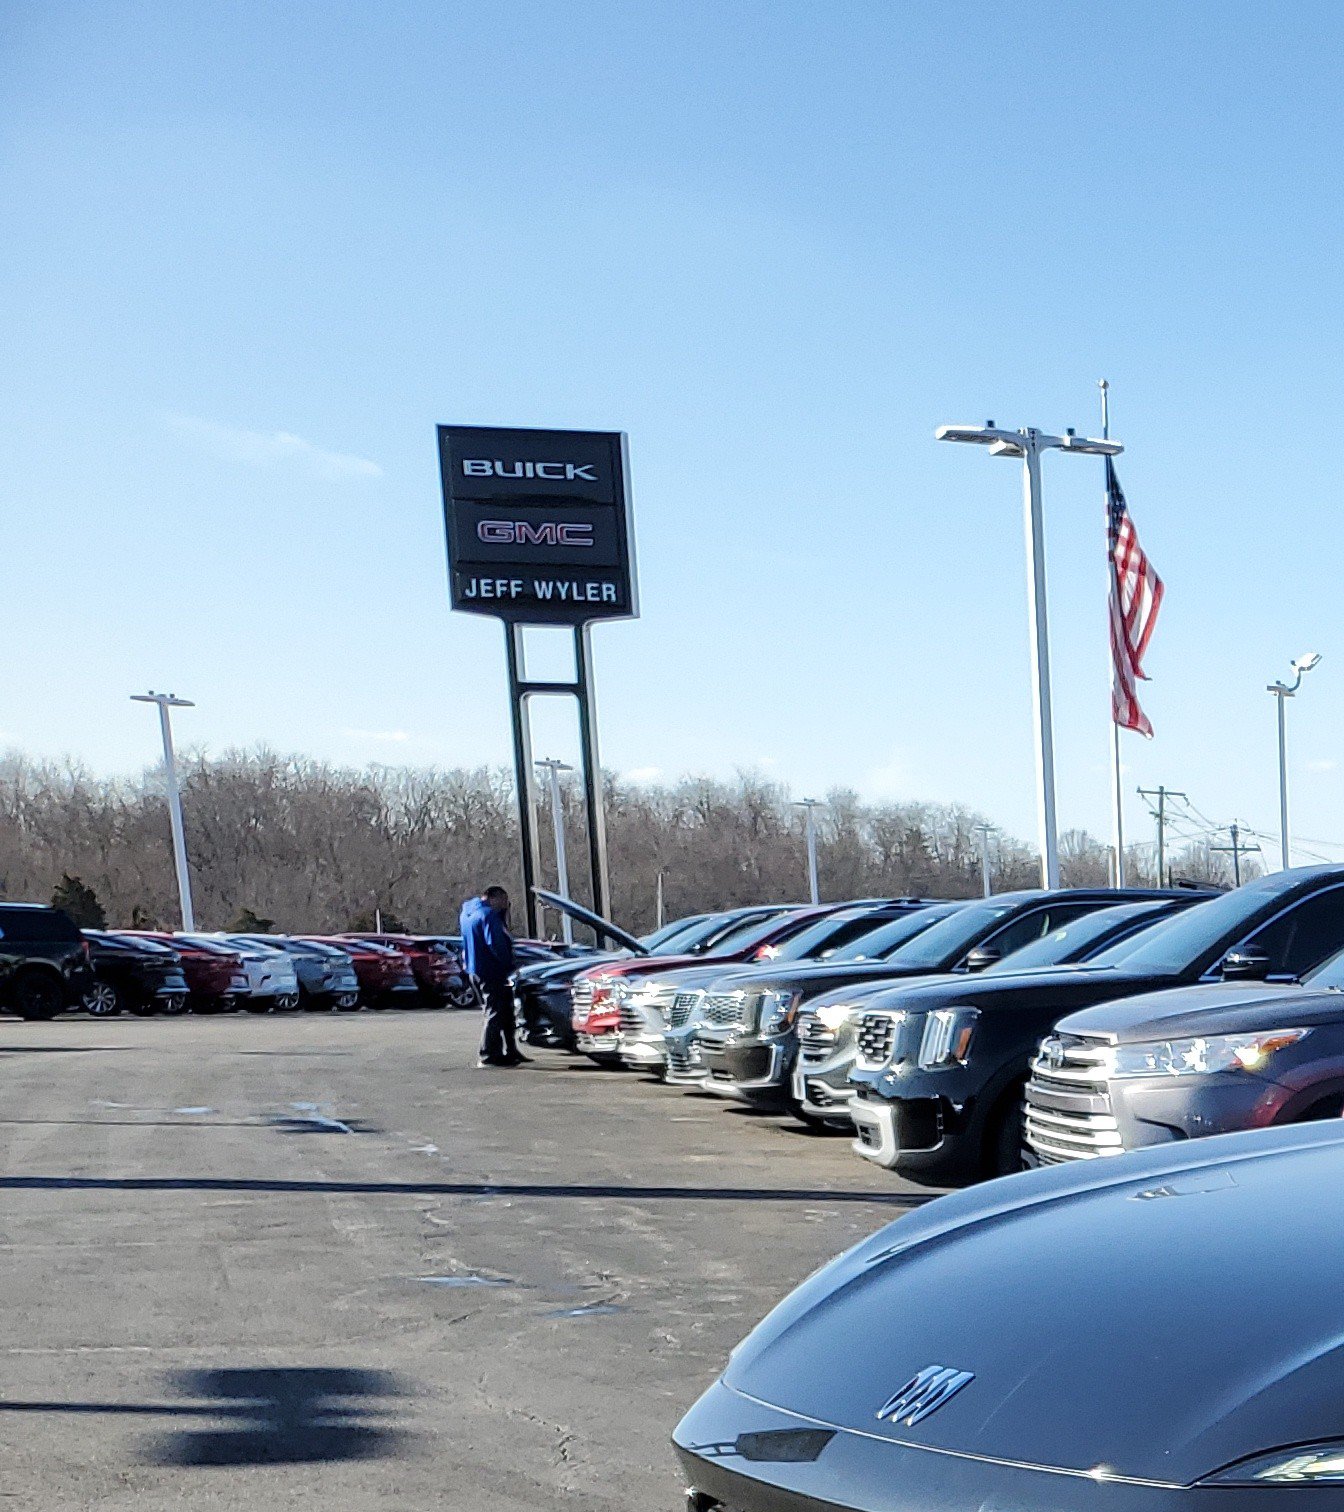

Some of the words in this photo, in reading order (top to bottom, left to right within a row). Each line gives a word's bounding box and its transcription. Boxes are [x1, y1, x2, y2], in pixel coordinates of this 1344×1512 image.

[462, 459, 598, 481] BUICK
[477, 520, 594, 546] GMC
[465, 578, 524, 599] JEFF
[534, 580, 617, 602] WYLER
